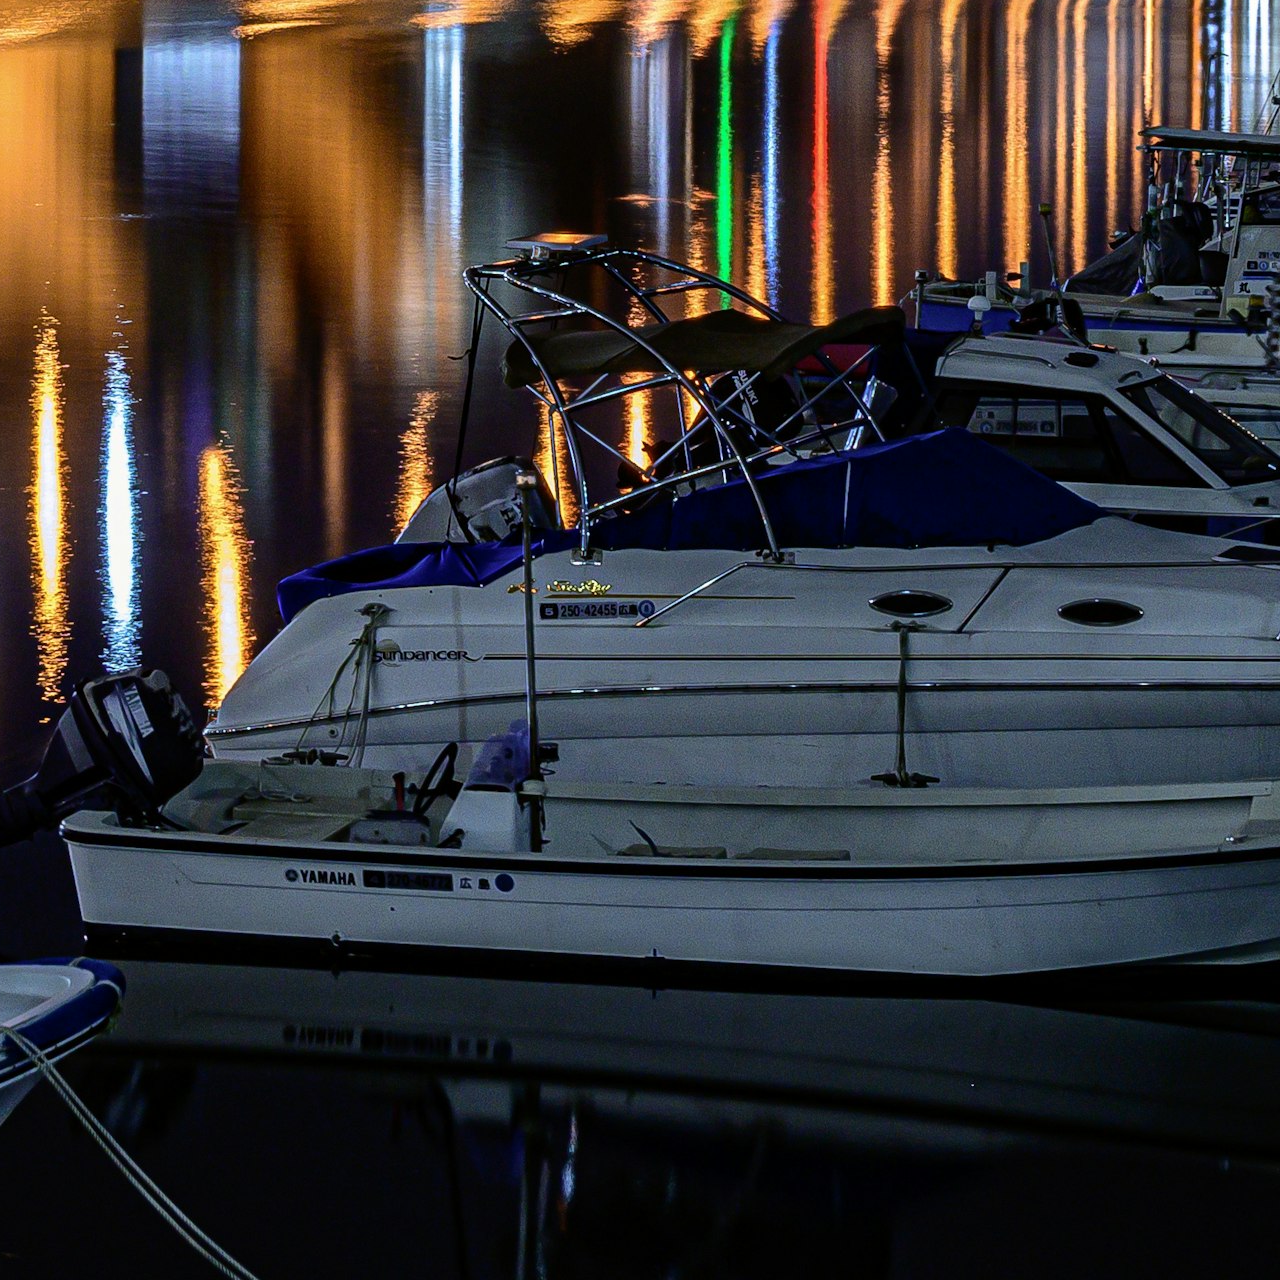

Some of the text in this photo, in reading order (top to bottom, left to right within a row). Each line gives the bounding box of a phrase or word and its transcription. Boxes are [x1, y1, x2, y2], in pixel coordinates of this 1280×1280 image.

[1239, 282, 1251, 294] 丸
[738, 370, 759, 405] SUUKI
[299, 869, 357, 886] YAMAHA
